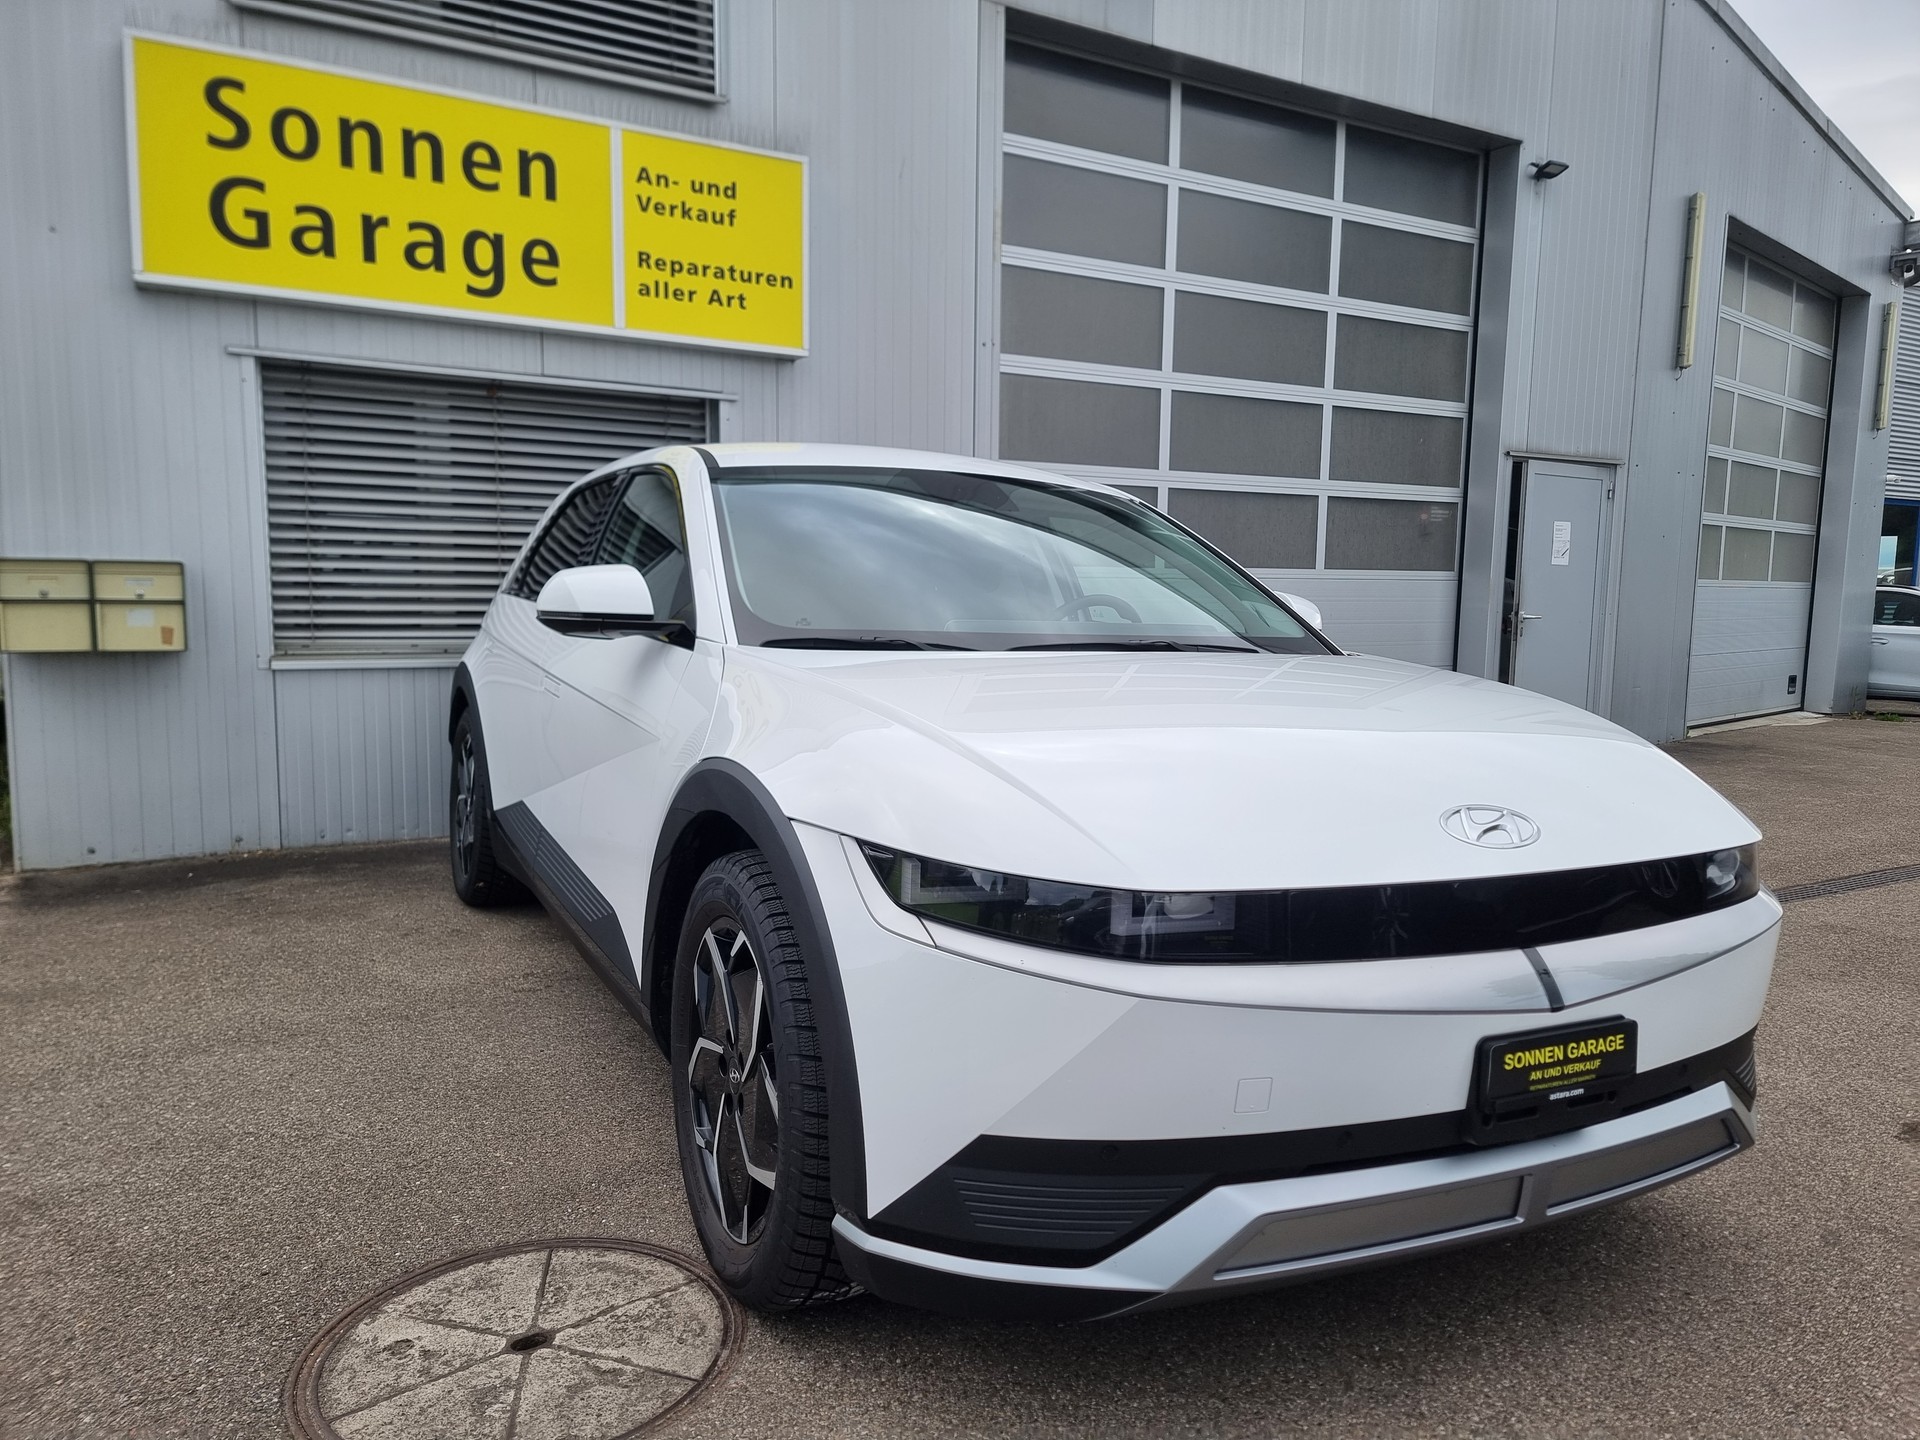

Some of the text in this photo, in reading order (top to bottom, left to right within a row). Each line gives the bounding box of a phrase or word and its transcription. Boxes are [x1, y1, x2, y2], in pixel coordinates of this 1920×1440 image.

[204, 76, 557, 201] Sonnen
[636, 166, 737, 200] An- und
[637, 194, 736, 227] Verkauf
[209, 176, 560, 299] Garage
[638, 251, 793, 289] Reparaturen
[638, 279, 746, 310] aller Art
[1504, 1034, 1624, 1070] SONNEN GARAGE
[1529, 1059, 1602, 1081] AN UND VERKAUF
[1549, 1088, 1585, 1100] astara.com
